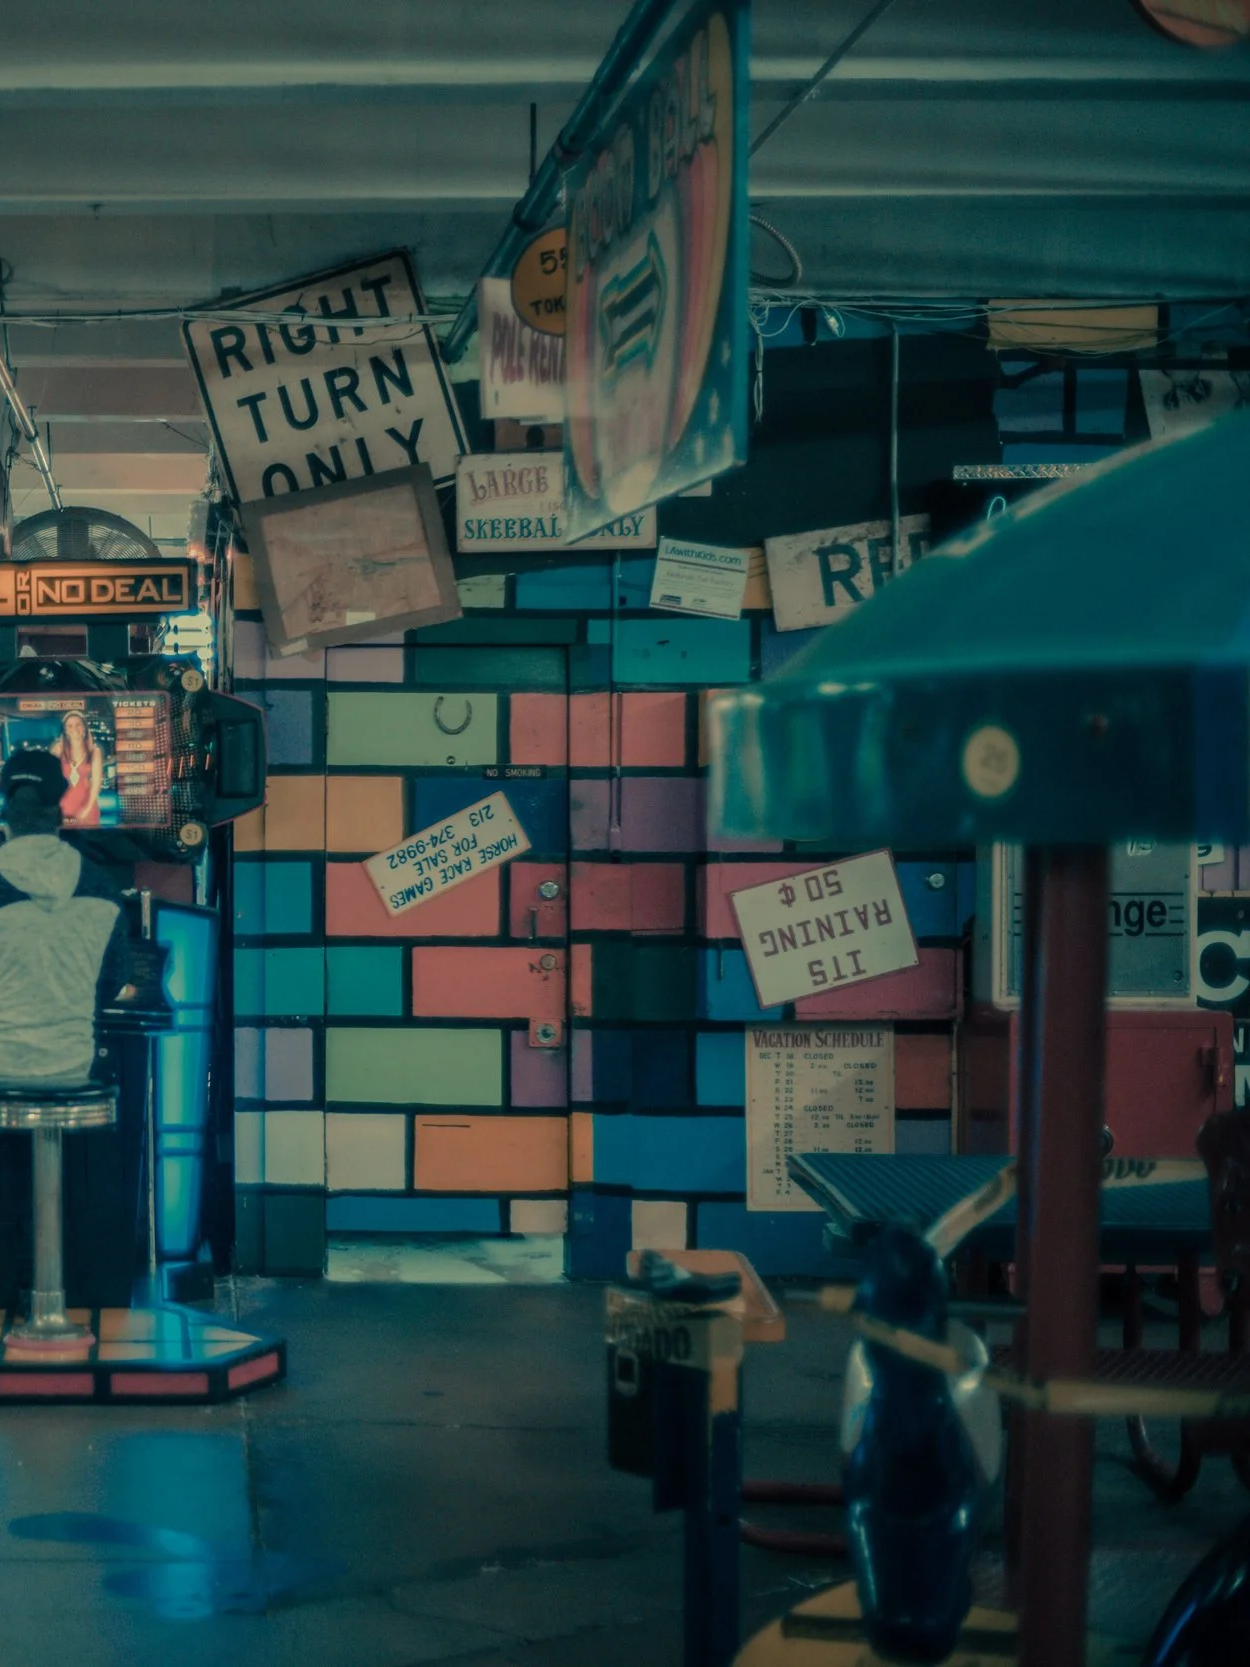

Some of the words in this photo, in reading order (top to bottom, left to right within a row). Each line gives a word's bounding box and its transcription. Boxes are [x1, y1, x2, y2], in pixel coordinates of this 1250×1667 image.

[209, 274, 395, 381] RIGHT
[237, 348, 416, 444] TURN
[464, 465, 549, 502] LARGE
[590, 515, 645, 538] NLY
[16, 571, 32, 616] OR
[37, 579, 84, 603] NO
[90, 578, 182, 603] DEAL
[184, 675, 199, 688] $1
[486, 768, 498, 778] NO
[505, 767, 541, 778] SMOKING
[468, 804, 495, 828] 213
[185, 828, 198, 840] $1
[386, 825, 456, 870] 374-9982
[449, 833, 478, 854] FOR
[480, 832, 518, 862] HORSE
[417, 851, 448, 876] SALE
[440, 856, 472, 885] RACE
[389, 875, 433, 910] GAMES
[758, 898, 893, 958] RAINING
[806, 949, 867, 987] ITS
[752, 1029, 812, 1049] VACATION
[814, 1028, 885, 1049] SCHEDULE
[803, 1052, 834, 1060] CLOSED
